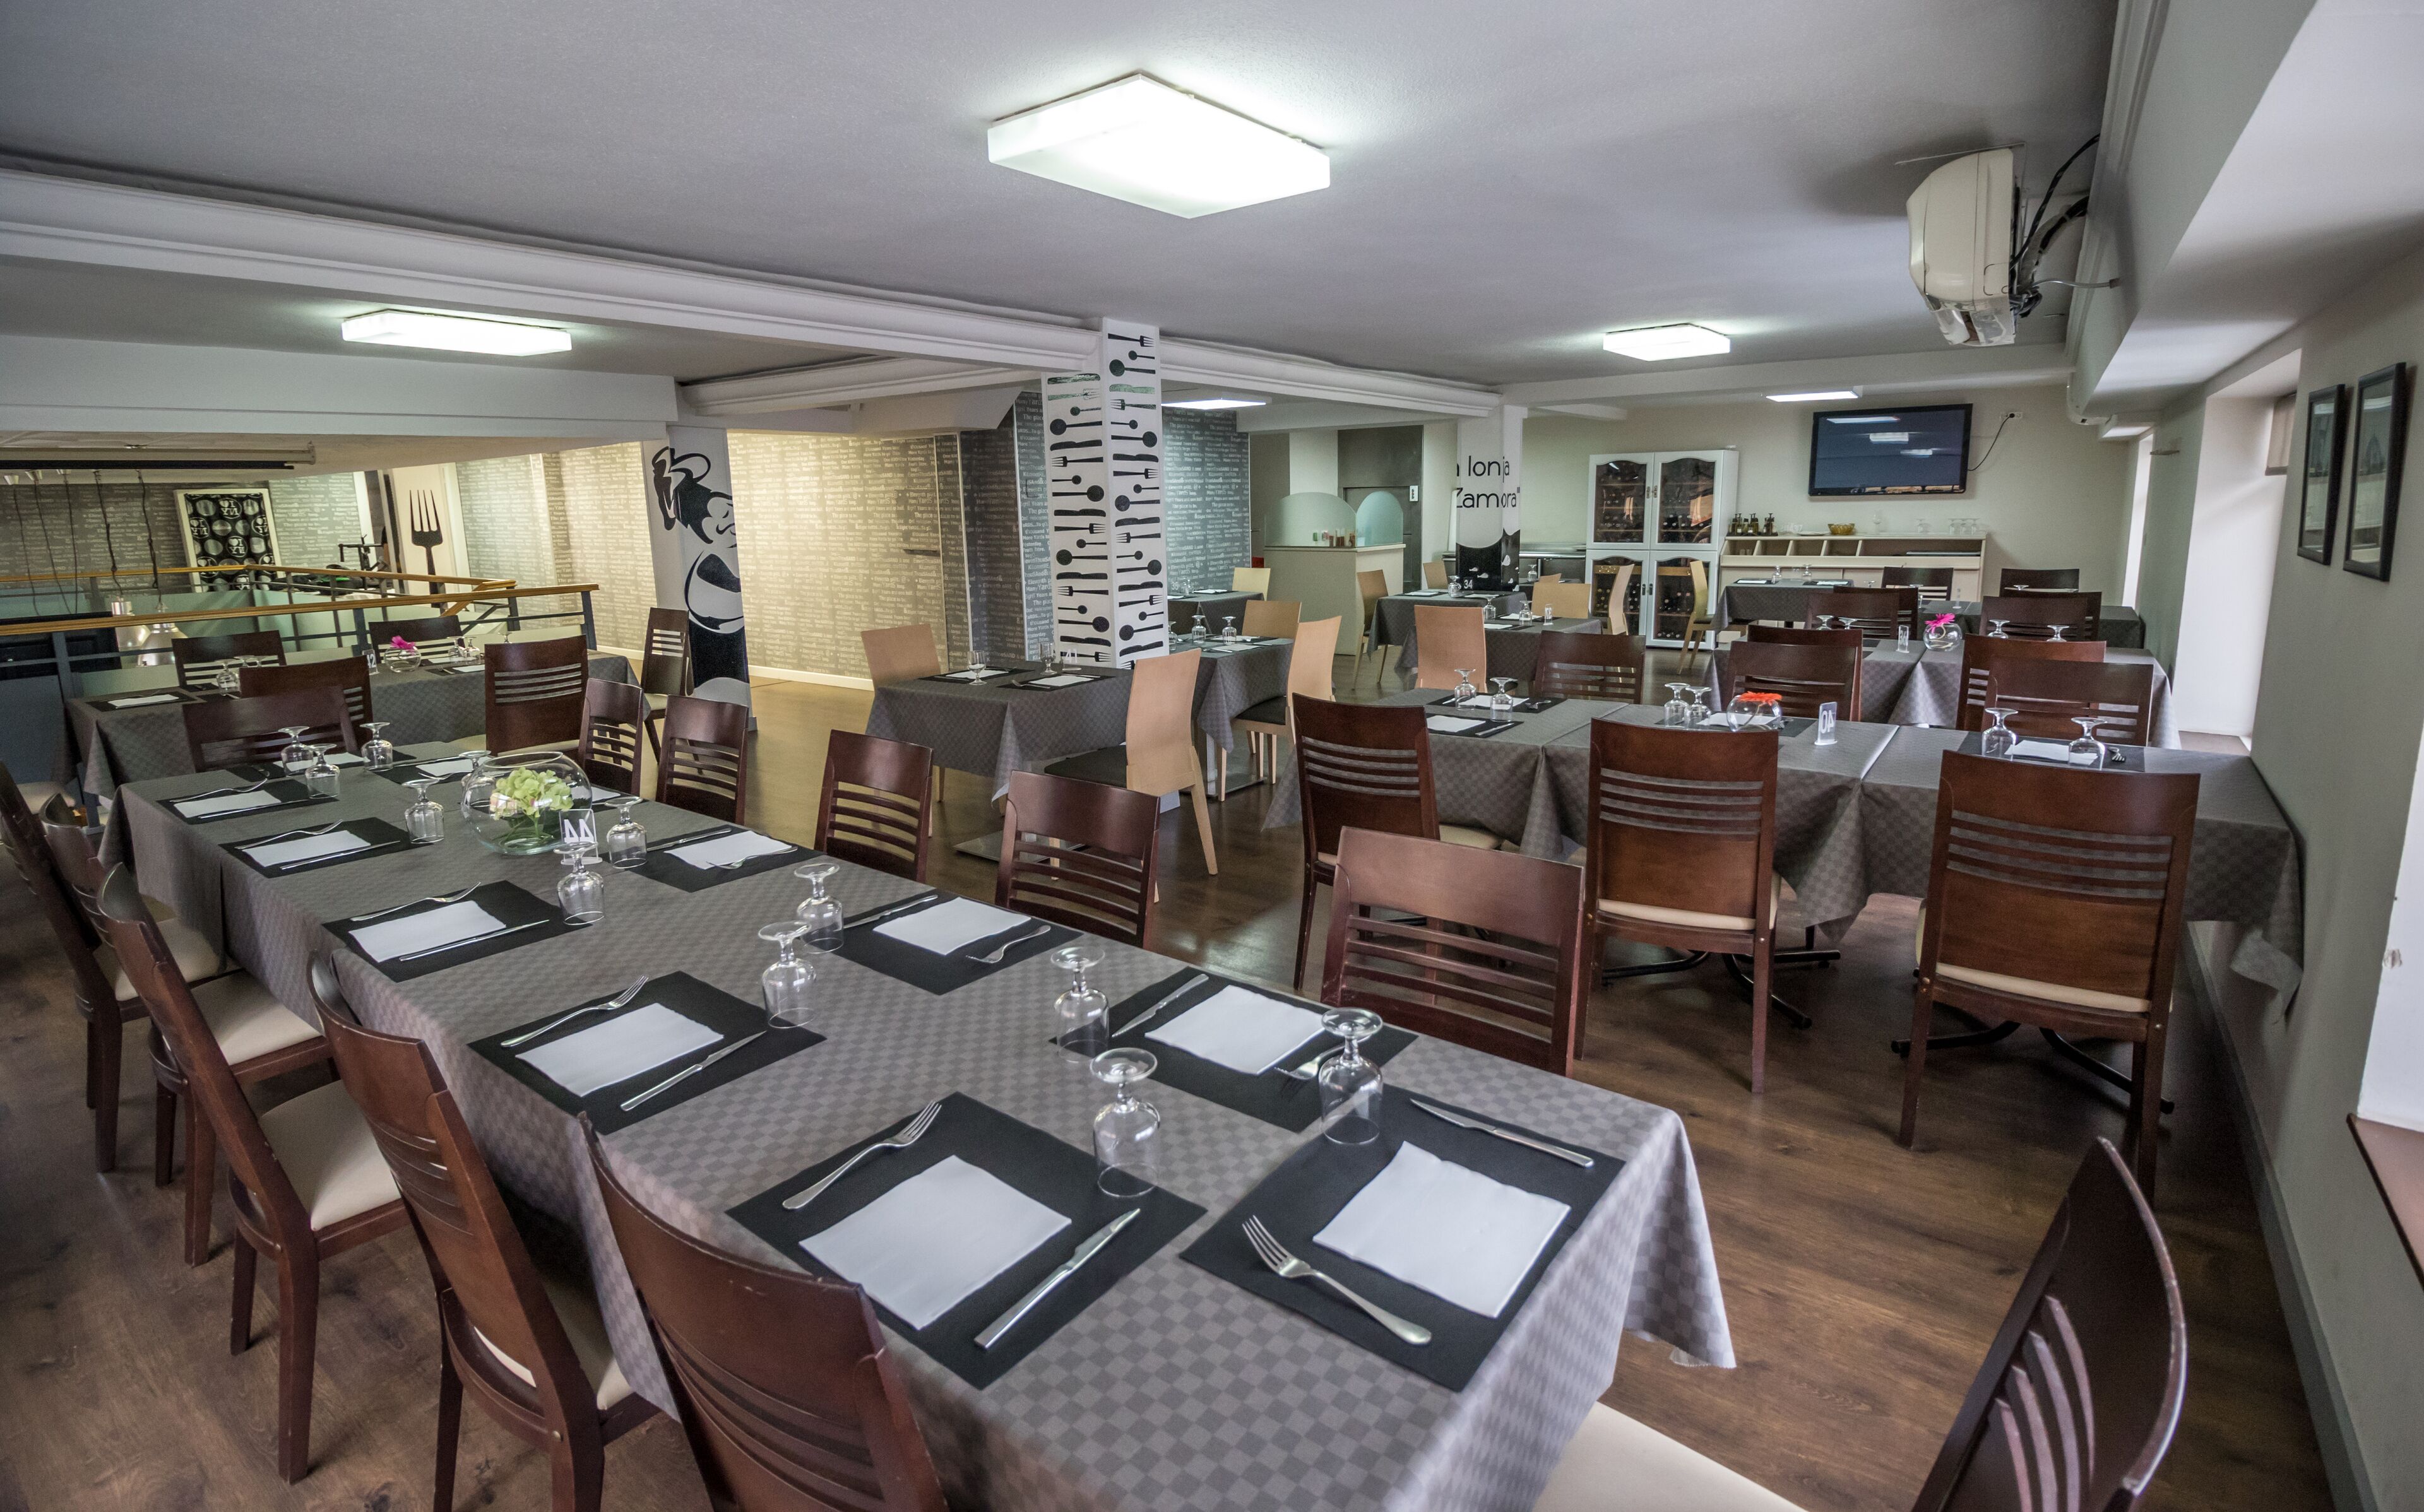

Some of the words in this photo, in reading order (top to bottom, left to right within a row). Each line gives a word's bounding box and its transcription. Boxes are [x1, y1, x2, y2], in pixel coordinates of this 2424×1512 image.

[1468, 455, 1510, 483] lonja
[1464, 579, 1473, 589] 34
[1066, 649, 1078, 663] 41
